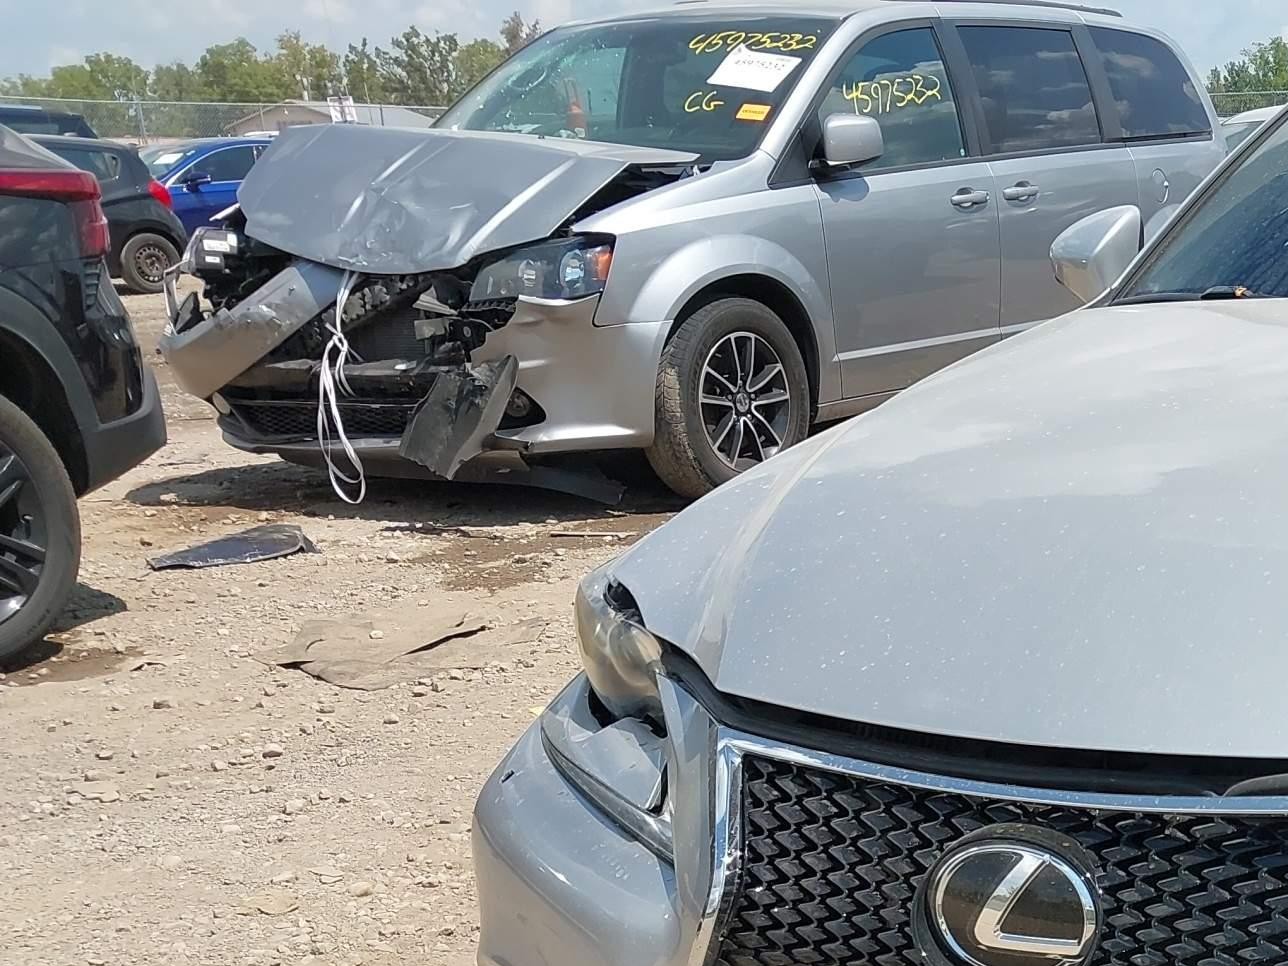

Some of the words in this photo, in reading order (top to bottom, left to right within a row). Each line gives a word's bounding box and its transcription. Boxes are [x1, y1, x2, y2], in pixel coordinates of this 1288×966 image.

[689, 31, 817, 55] 45975232
[684, 90, 725, 112] CG
[842, 75, 941, 116] 45975232
